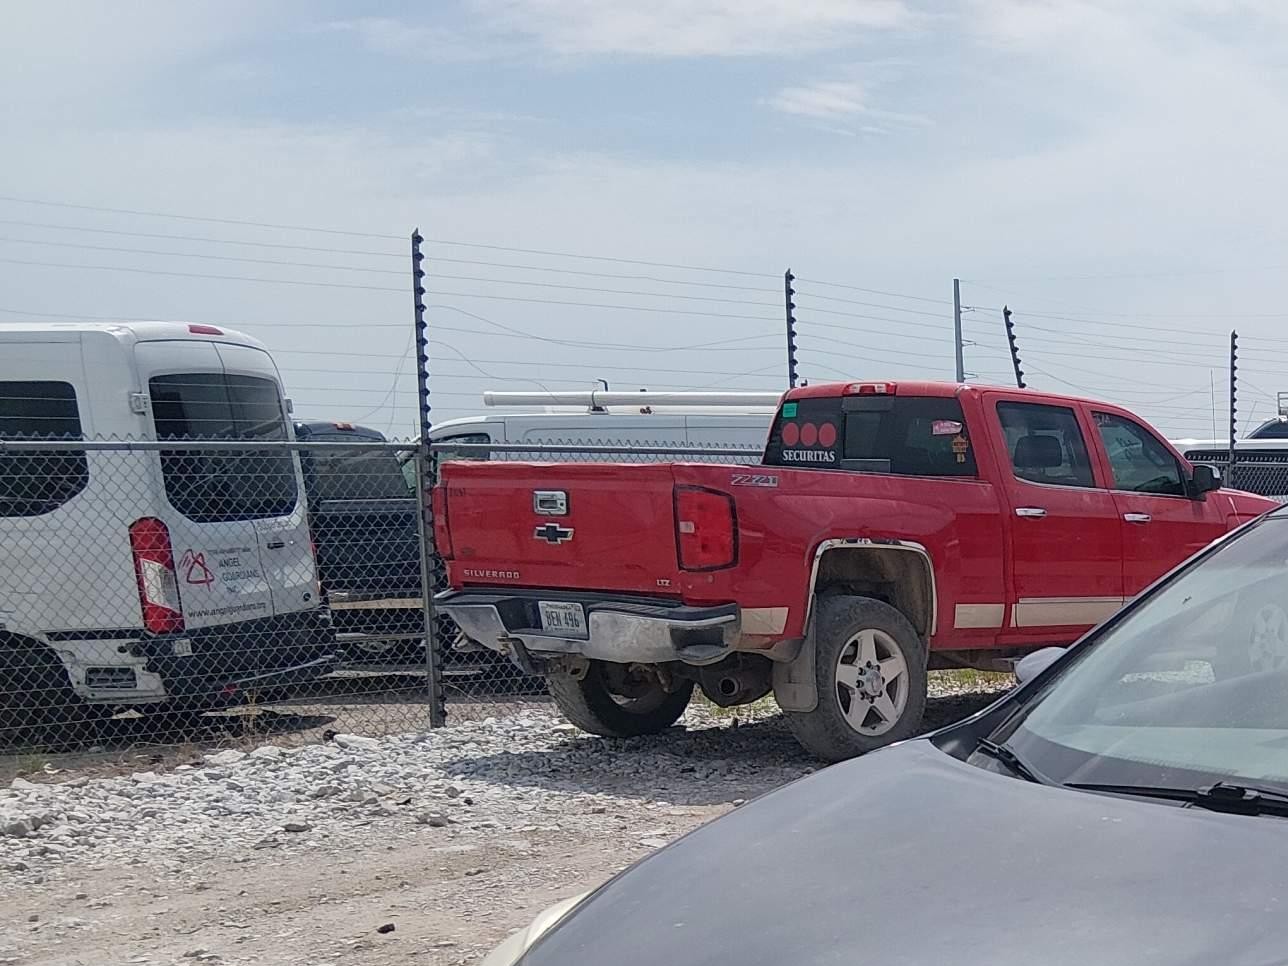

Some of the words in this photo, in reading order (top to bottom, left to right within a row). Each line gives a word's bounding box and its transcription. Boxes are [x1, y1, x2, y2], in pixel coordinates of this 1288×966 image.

[783, 449, 835, 462] SECURITAS
[218, 557, 241, 567] ANGEL
[463, 568, 520, 579] SILVERADO
[656, 578, 671, 587] LTZ
[564, 612, 580, 628] 496
